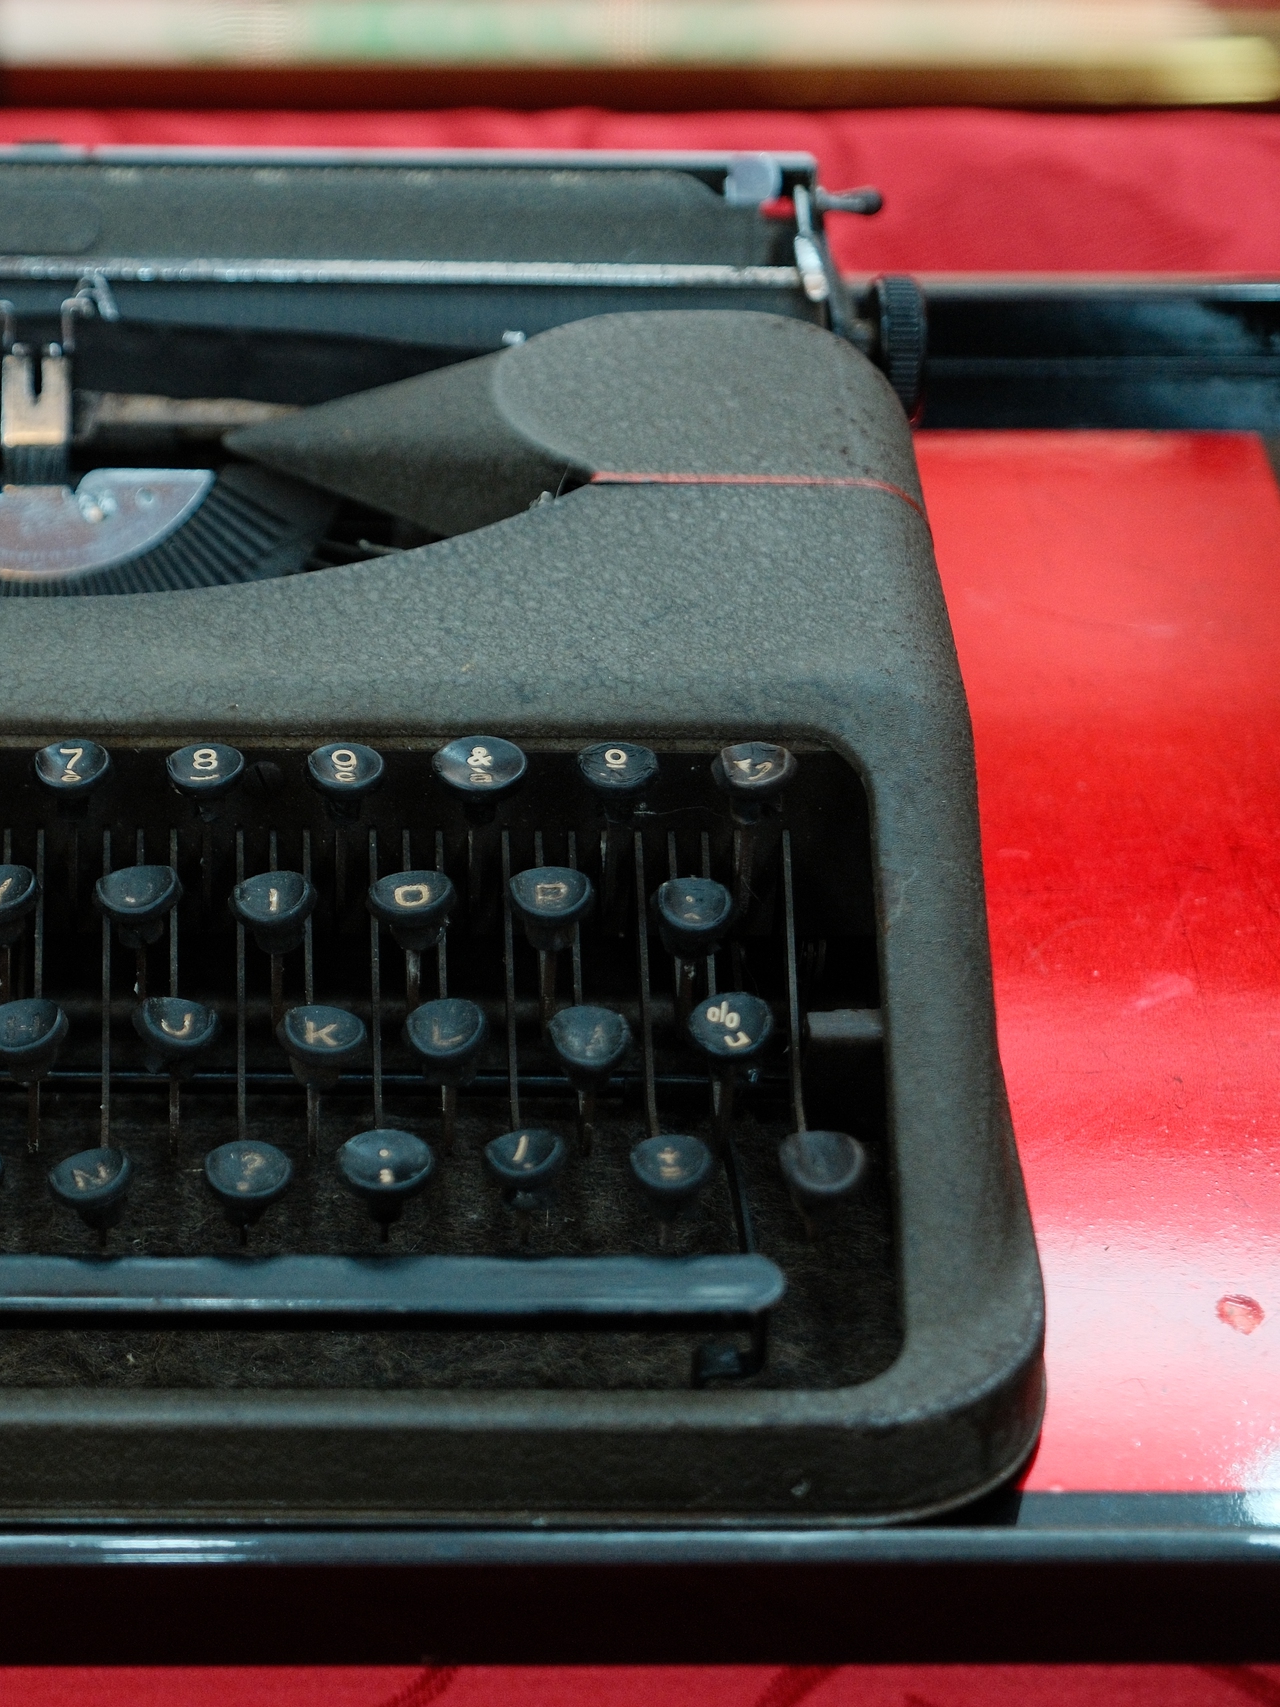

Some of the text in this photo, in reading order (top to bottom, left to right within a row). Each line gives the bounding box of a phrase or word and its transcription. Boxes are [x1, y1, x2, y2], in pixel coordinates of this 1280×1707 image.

[60, 748, 82, 770] 7
[193, 749, 217, 770] 8
[332, 750, 357, 773] 9
[467, 747, 492, 769] &
[270, 888, 277, 911] I
[394, 884, 429, 907] O
[161, 1014, 192, 1037] J
[707, 1002, 740, 1029] %
[305, 1021, 336, 1046] K
[432, 1018, 462, 1047] L
[73, 1164, 110, 1190] N
